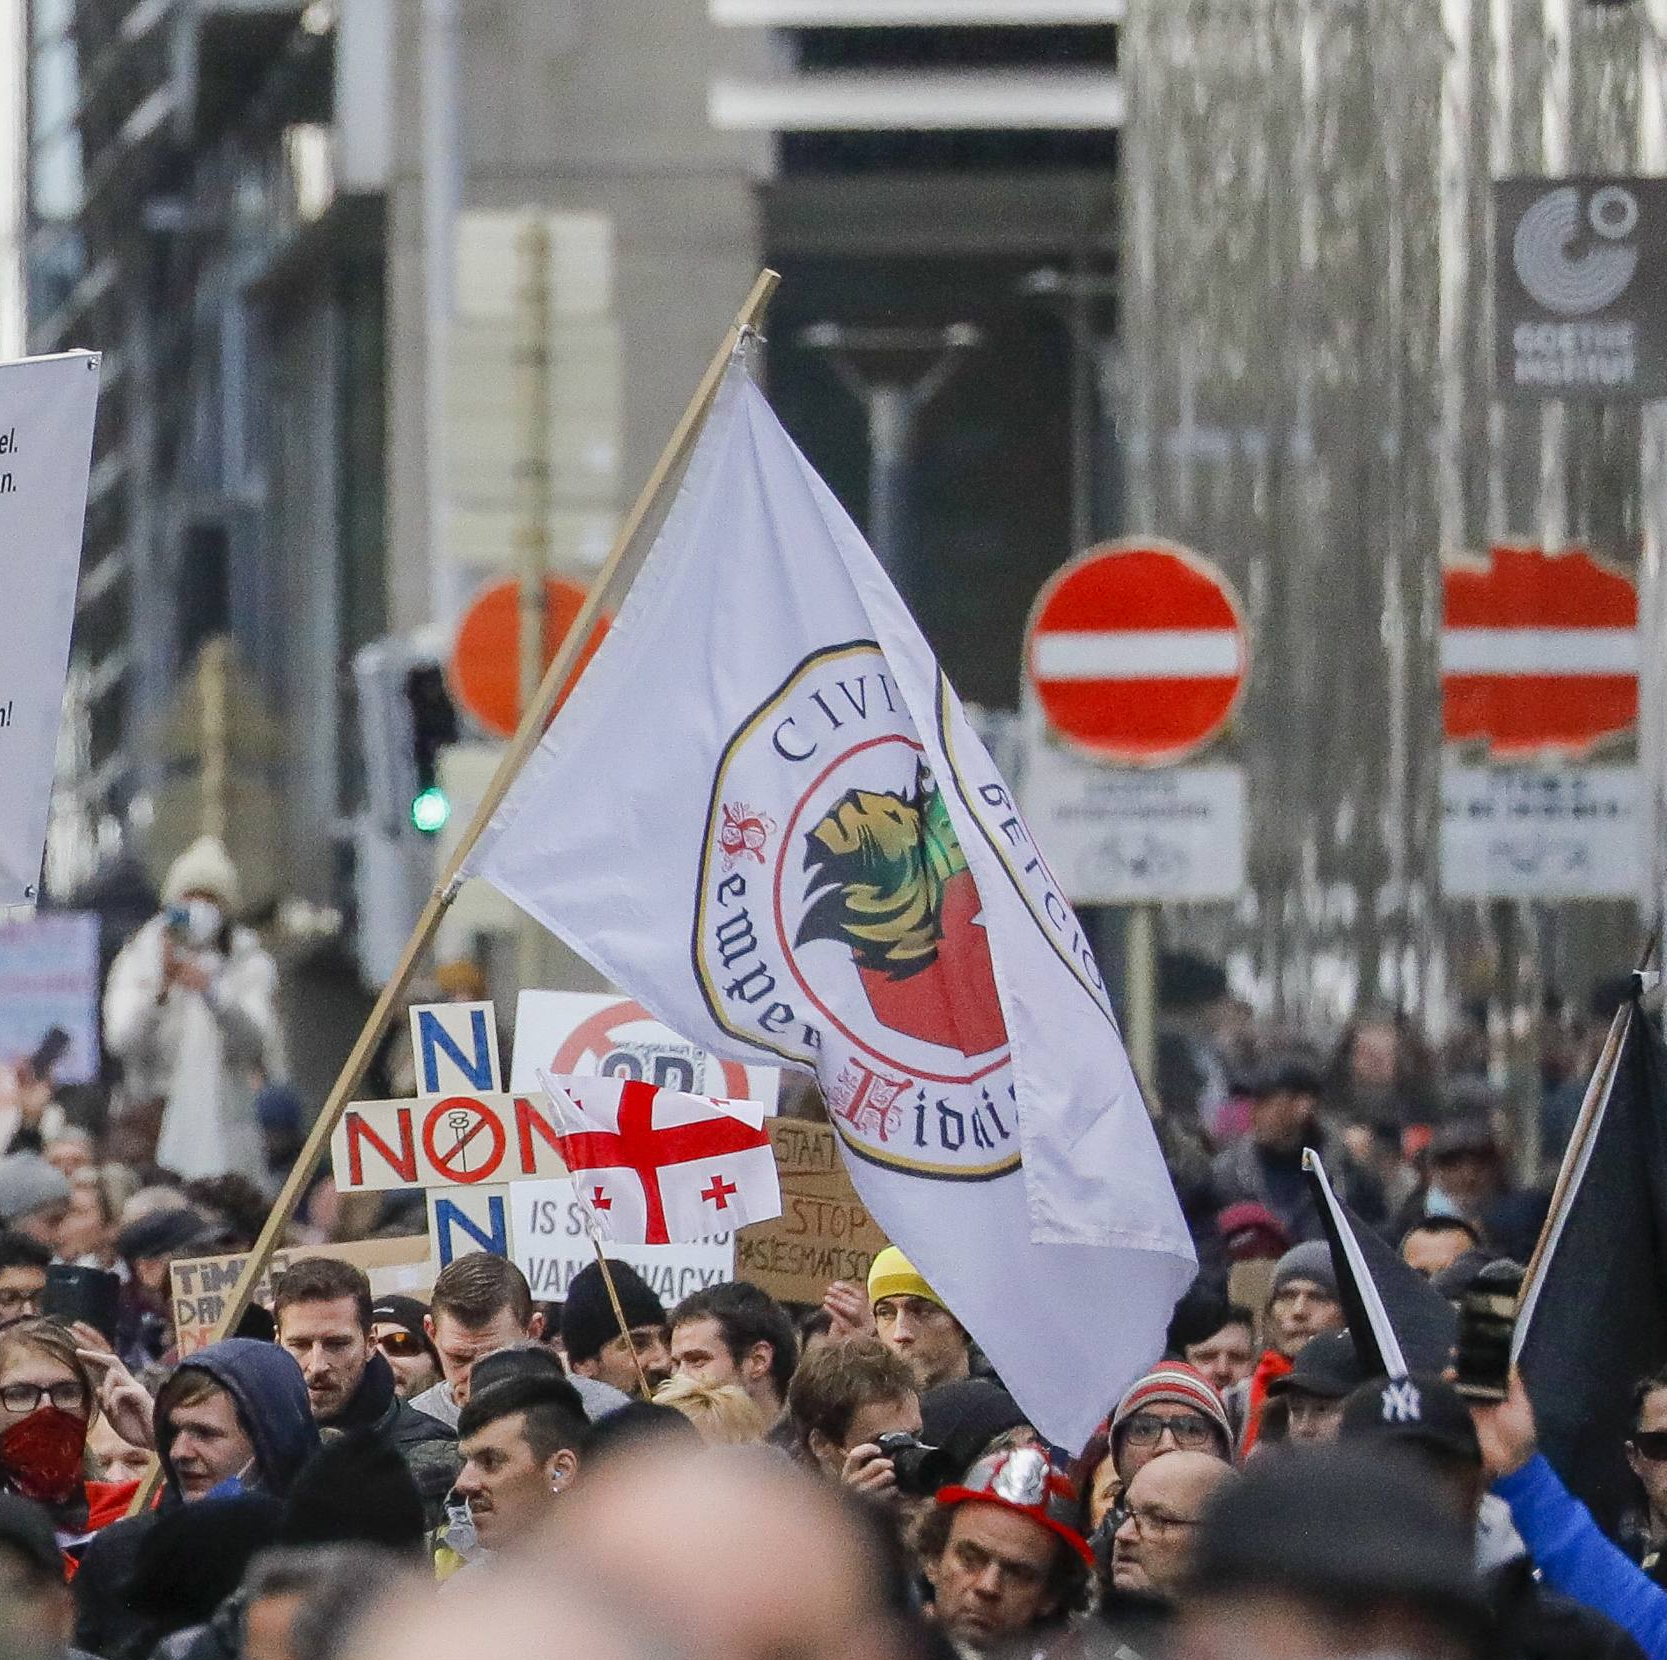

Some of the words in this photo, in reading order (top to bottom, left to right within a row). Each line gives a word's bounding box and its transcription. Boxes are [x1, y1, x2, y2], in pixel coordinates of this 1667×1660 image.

[772, 673, 913, 762] CIVI
[418, 1011, 492, 1093] N
[531, 1200, 556, 1235] IS
[786, 1199, 866, 1239] STOP
